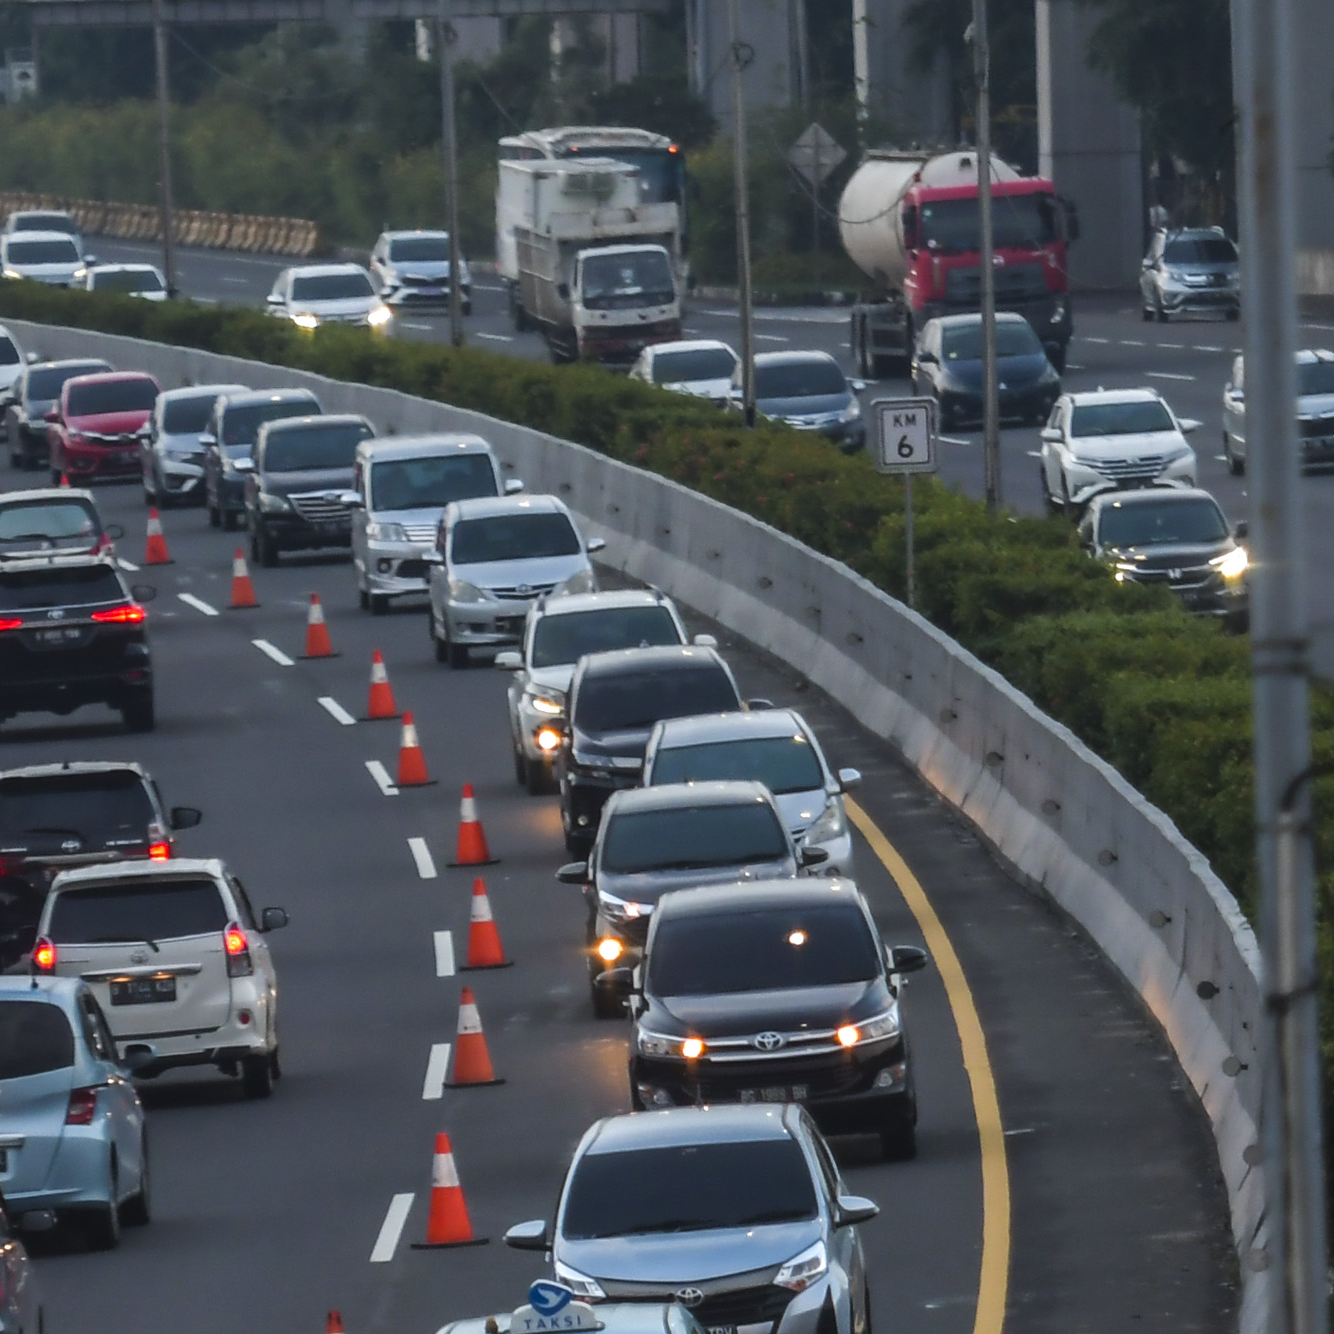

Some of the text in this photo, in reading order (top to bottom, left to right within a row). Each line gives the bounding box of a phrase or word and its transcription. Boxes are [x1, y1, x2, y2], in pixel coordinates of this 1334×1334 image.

[893, 414, 917, 427] KM
[898, 435, 914, 459] 6
[524, 1315, 582, 1330] TAKSI
